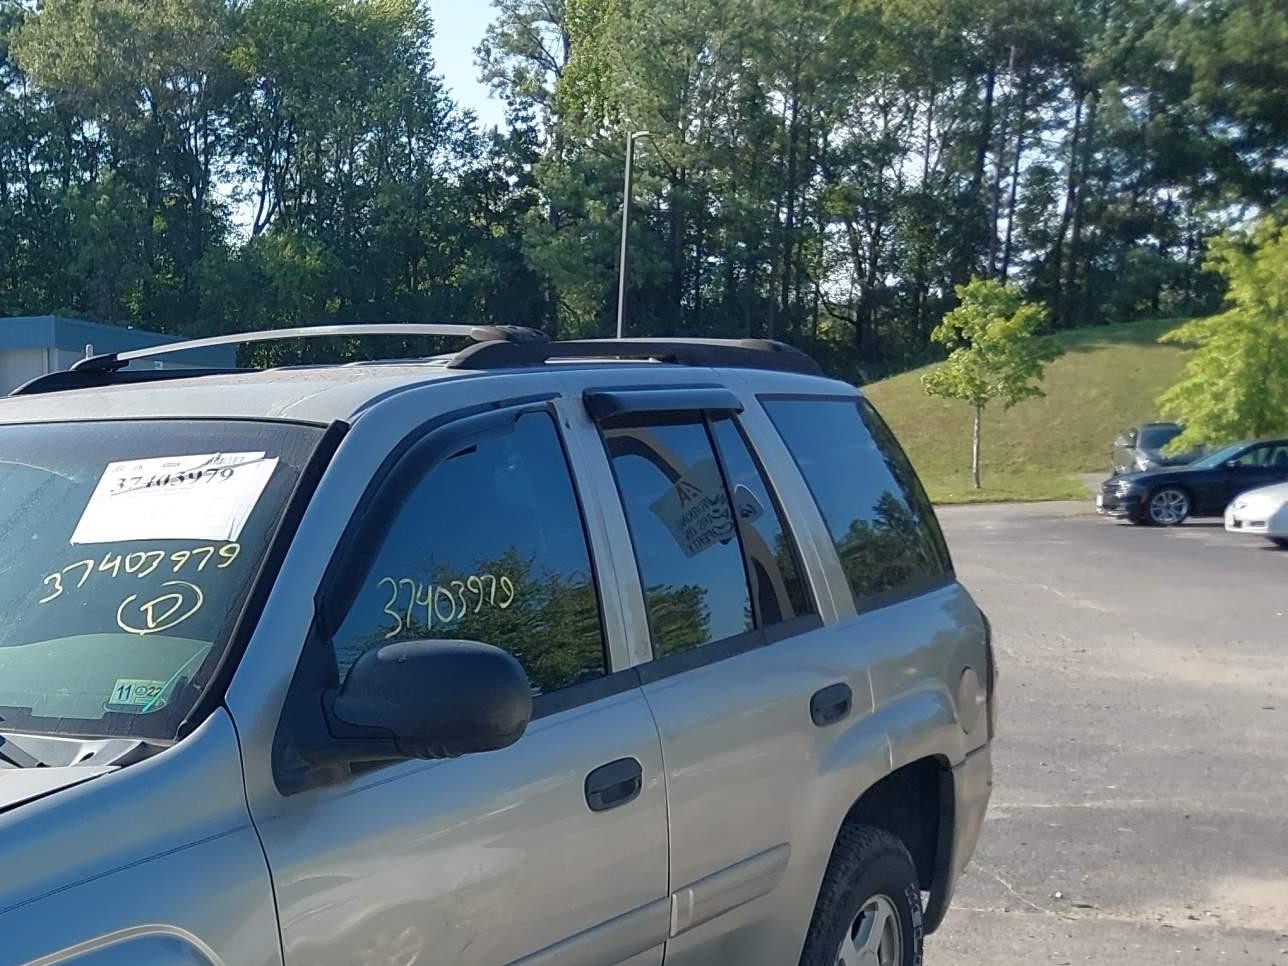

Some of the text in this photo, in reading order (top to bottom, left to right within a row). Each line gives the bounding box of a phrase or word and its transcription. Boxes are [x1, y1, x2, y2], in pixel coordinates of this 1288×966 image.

[38, 543, 241, 605] 37403979
[377, 574, 514, 640] 37403979
[117, 683, 133, 701] 11
